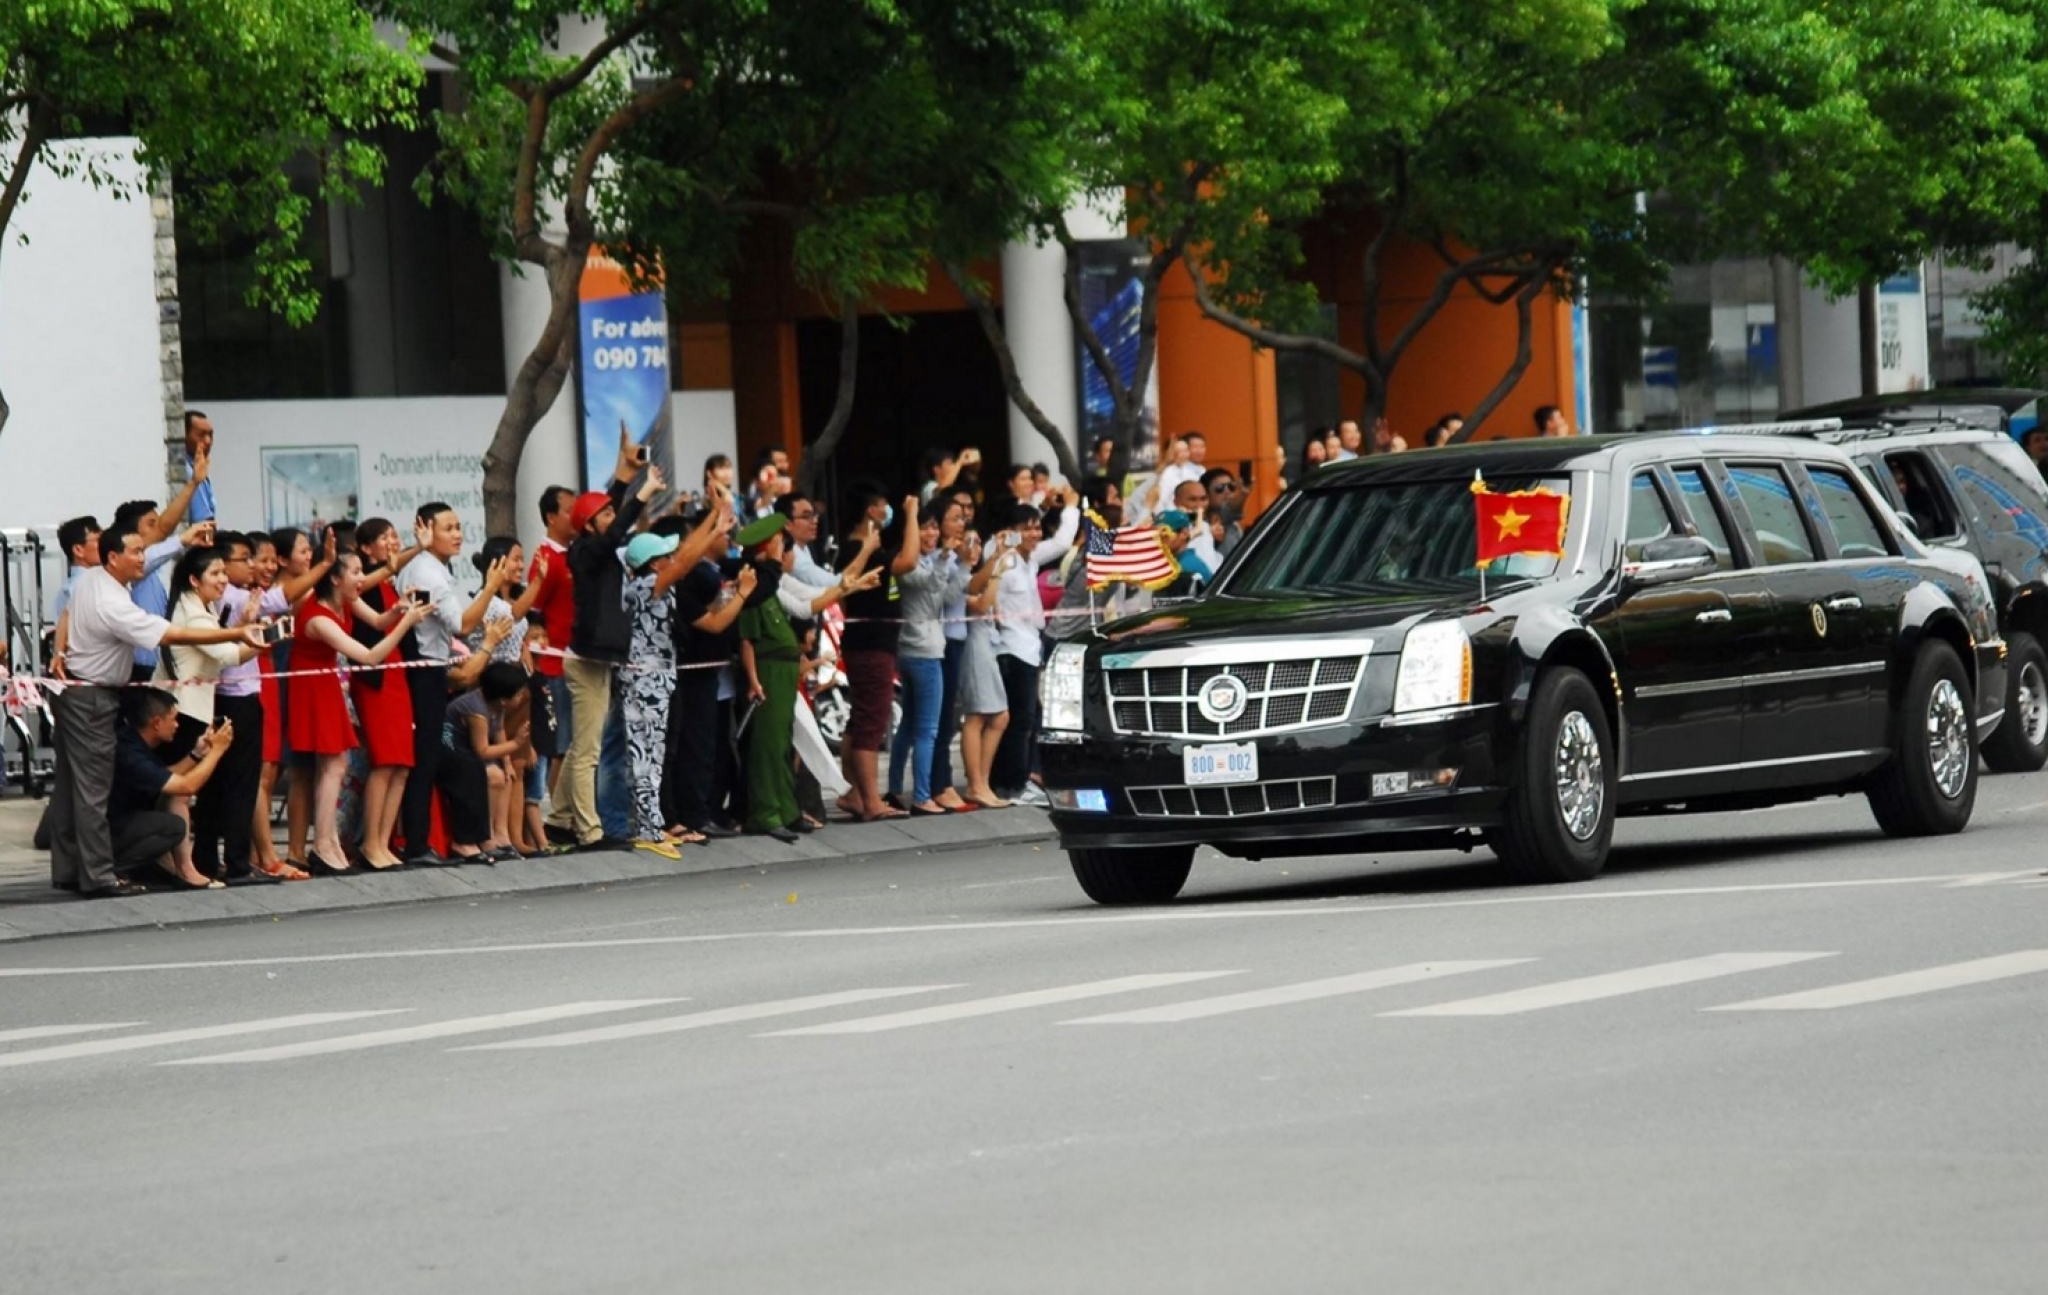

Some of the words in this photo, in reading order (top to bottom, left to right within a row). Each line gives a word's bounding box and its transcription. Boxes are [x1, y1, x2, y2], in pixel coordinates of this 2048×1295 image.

[592, 317, 627, 339] For
[593, 346, 638, 371] 090
[380, 452, 434, 476] Dominant
[382, 487, 415, 512] 100%
[1192, 755, 1214, 773] 800
[1229, 753, 1251, 771] 002
